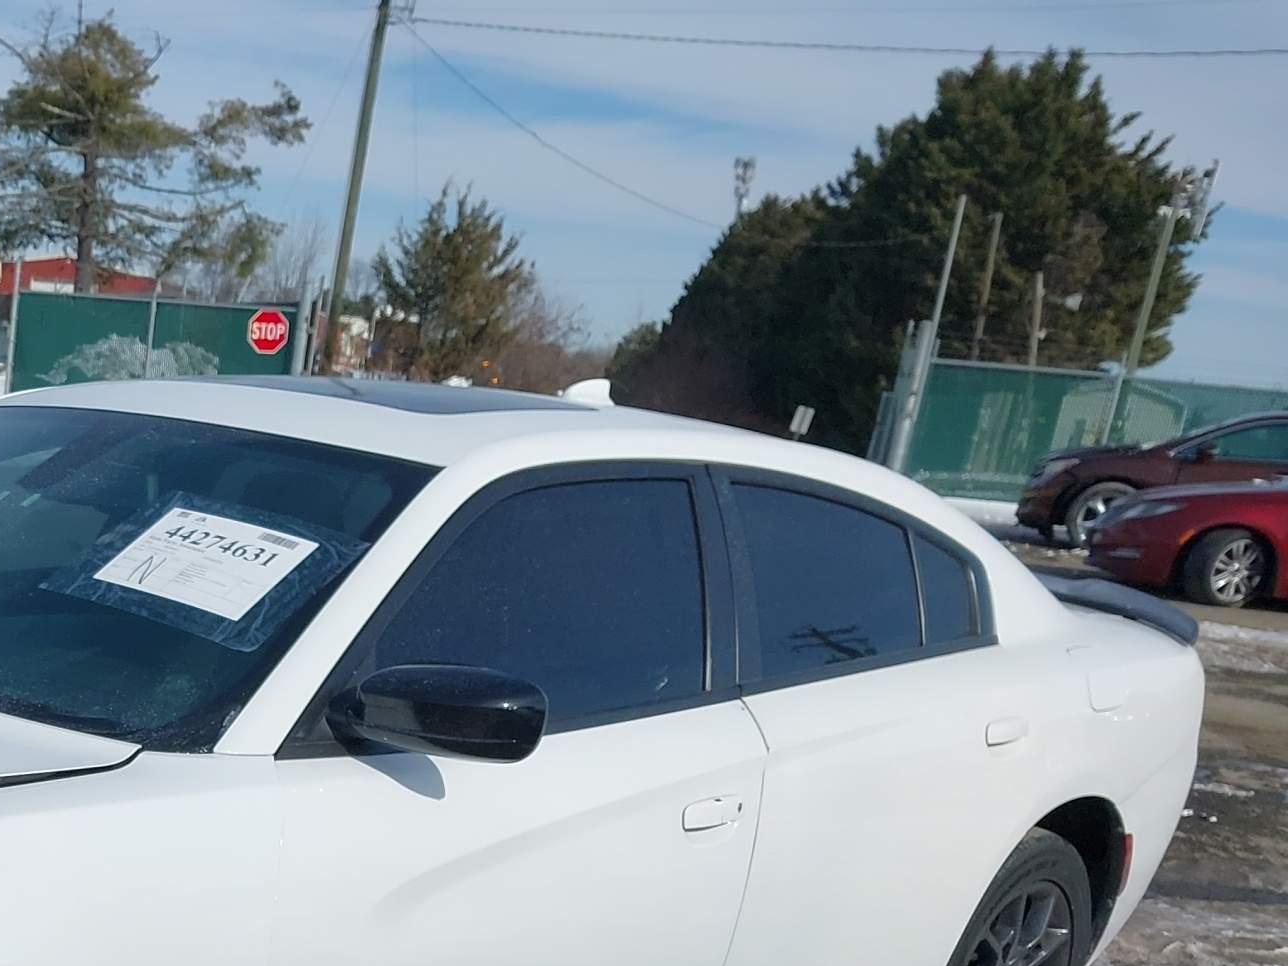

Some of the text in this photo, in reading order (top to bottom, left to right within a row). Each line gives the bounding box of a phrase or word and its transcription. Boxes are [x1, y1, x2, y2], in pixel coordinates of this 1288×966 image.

[252, 321, 286, 341] STOP
[165, 525, 279, 567] 44274631
[127, 554, 167, 585] N
